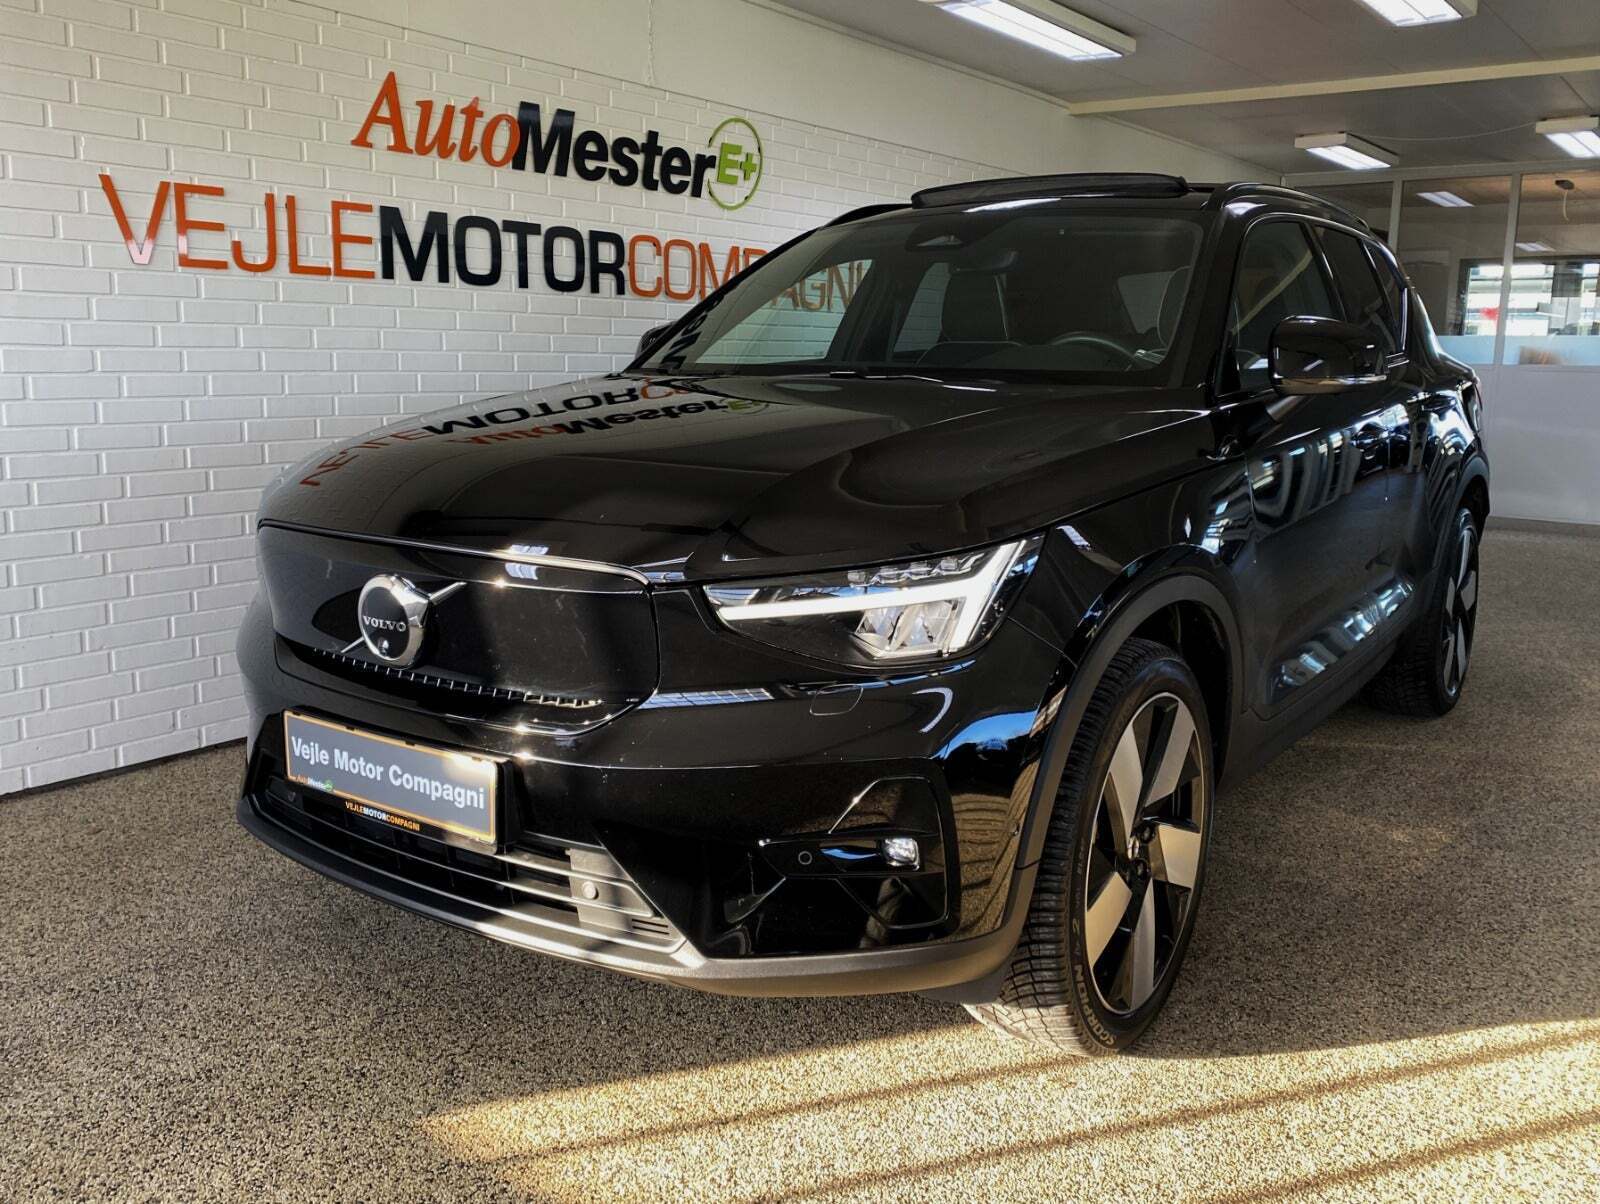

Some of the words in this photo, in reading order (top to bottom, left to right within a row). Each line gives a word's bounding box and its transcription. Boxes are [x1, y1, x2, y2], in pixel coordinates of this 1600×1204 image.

[351, 71, 716, 198] AutoMester
[363, 615, 406, 632] VOLVO
[291, 736, 329, 765] Vejle
[334, 749, 384, 781] Motor
[389, 765, 485, 809] Compagni
[345, 801, 420, 831] VEJLEMOTORCOMPAGNI
[1074, 964, 1117, 1046] SCORPION
